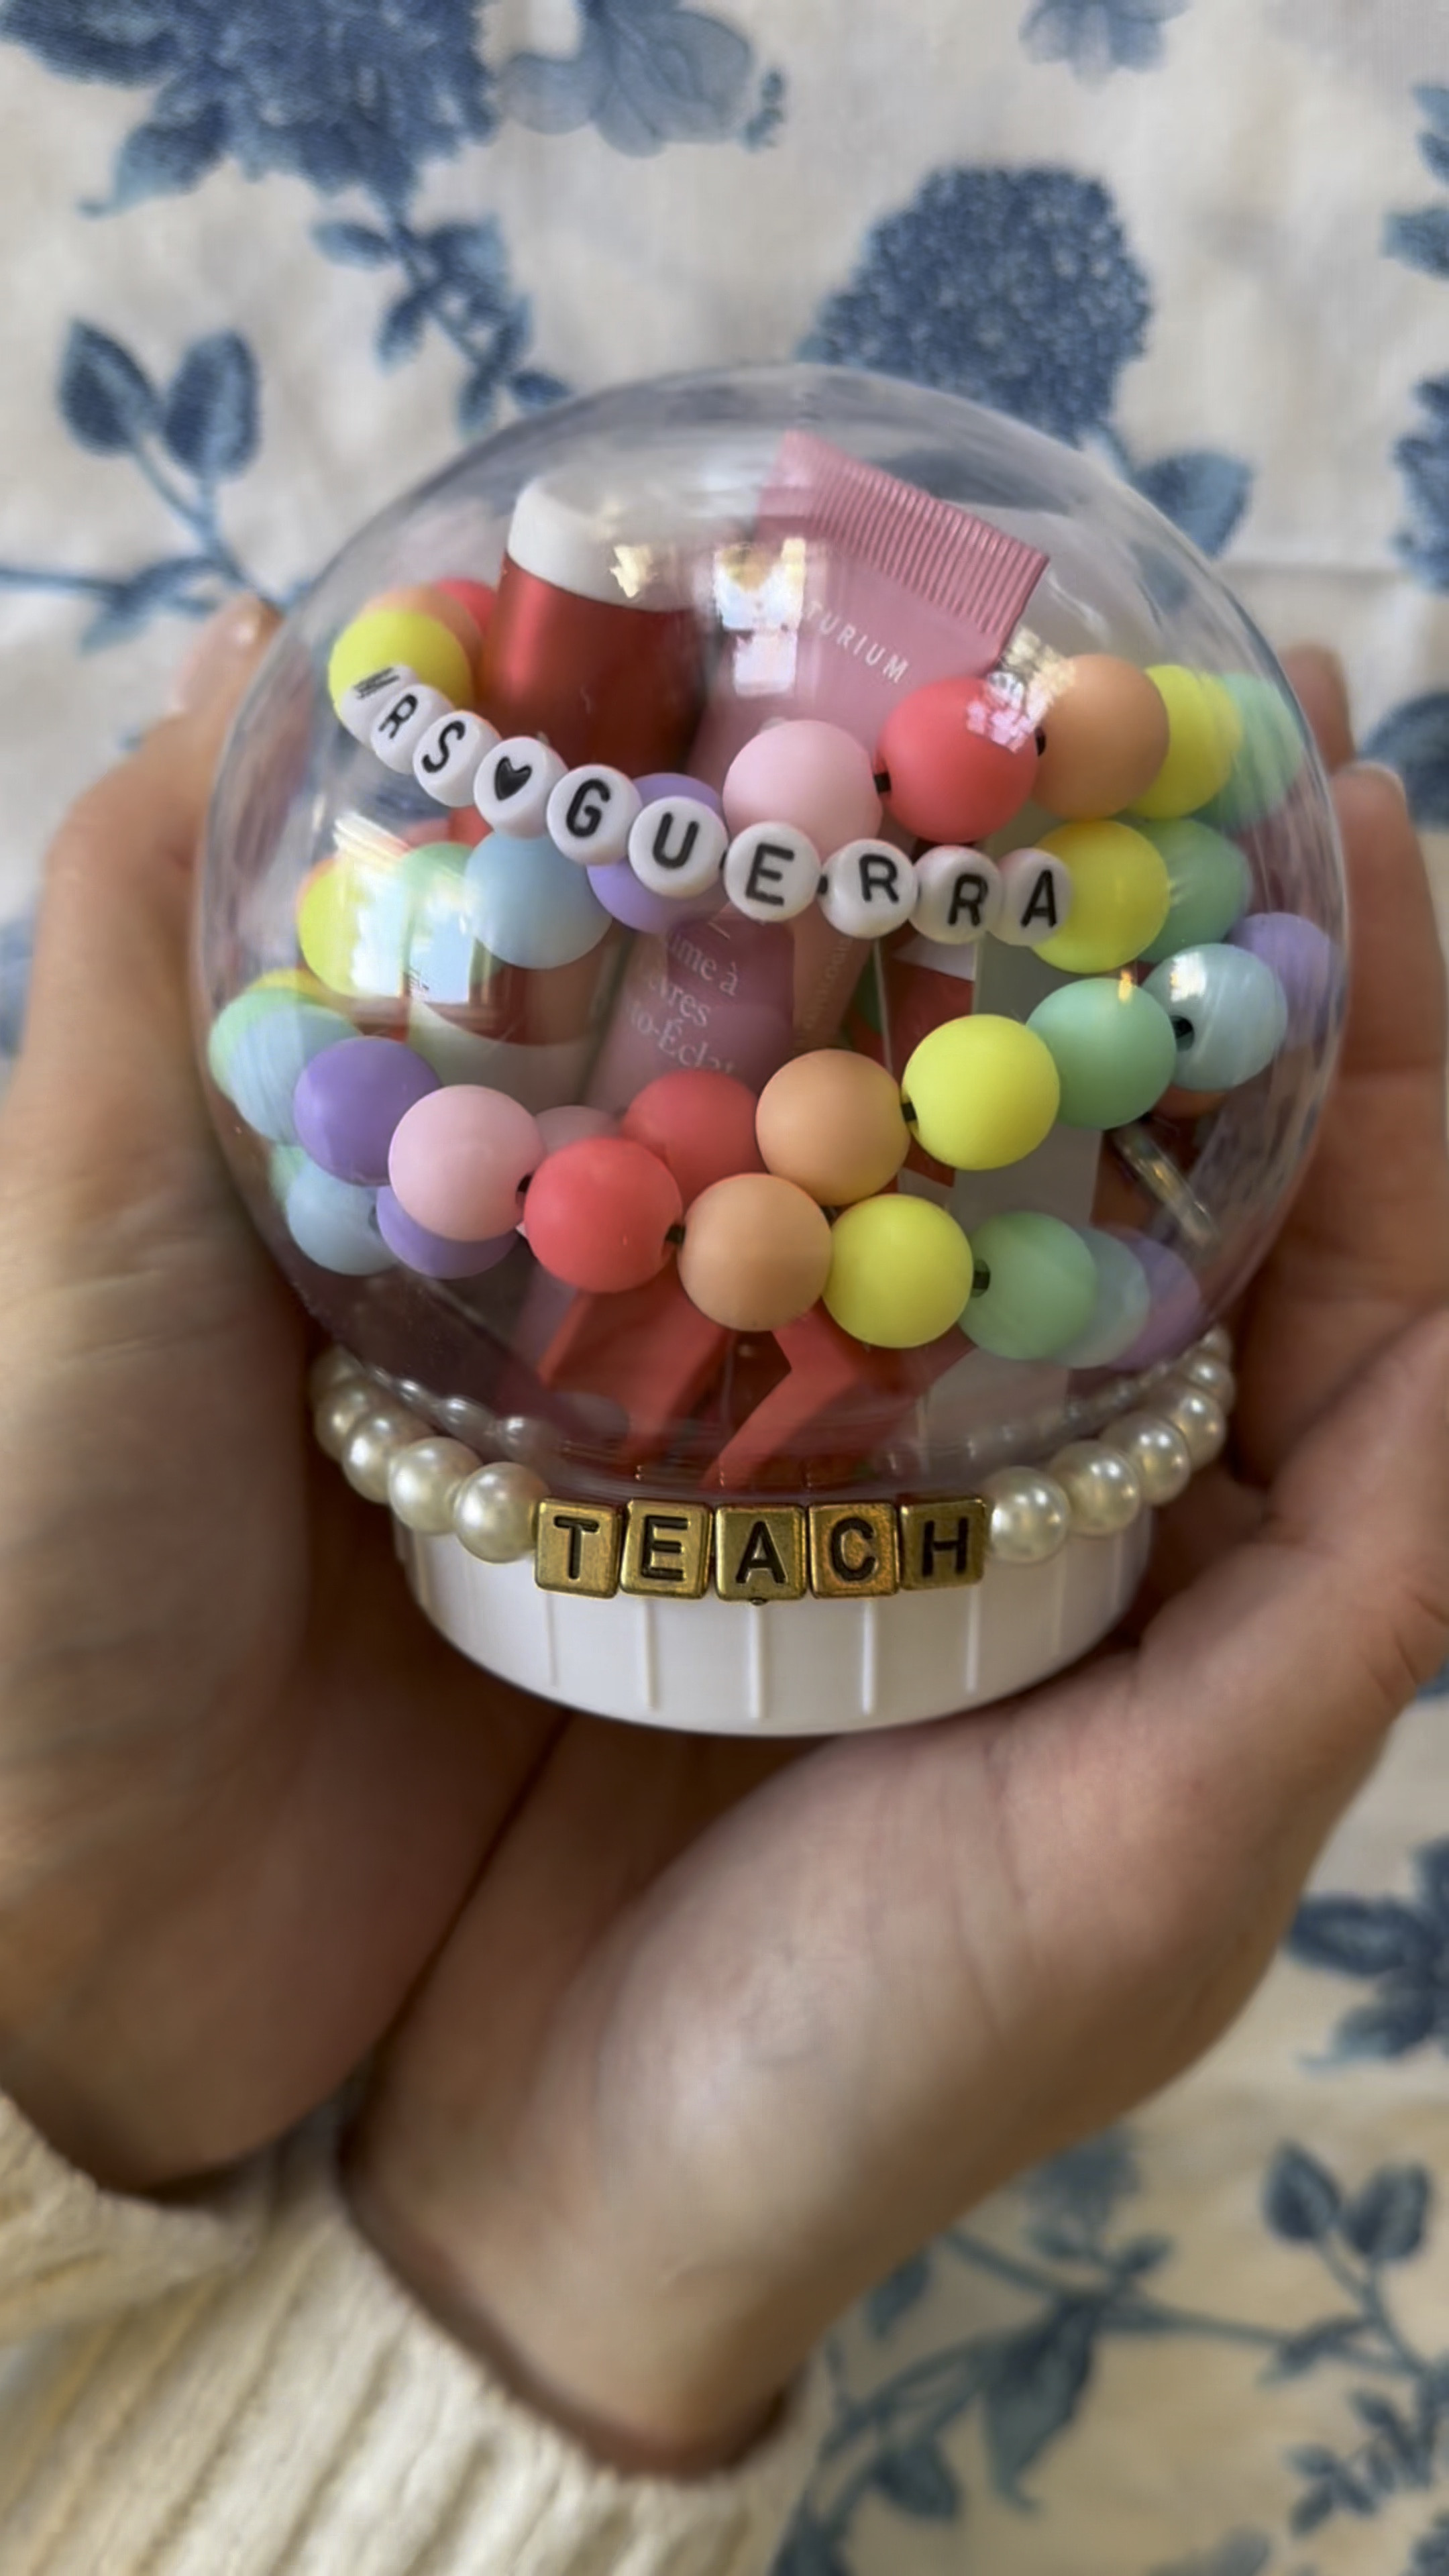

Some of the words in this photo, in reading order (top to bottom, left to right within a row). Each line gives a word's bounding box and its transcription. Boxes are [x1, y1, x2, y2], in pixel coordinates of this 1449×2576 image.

[805, 600, 911, 685] TURIUM
[566, 778, 1058, 928] GUERRA
[553, 1515, 969, 1585] TEACH
